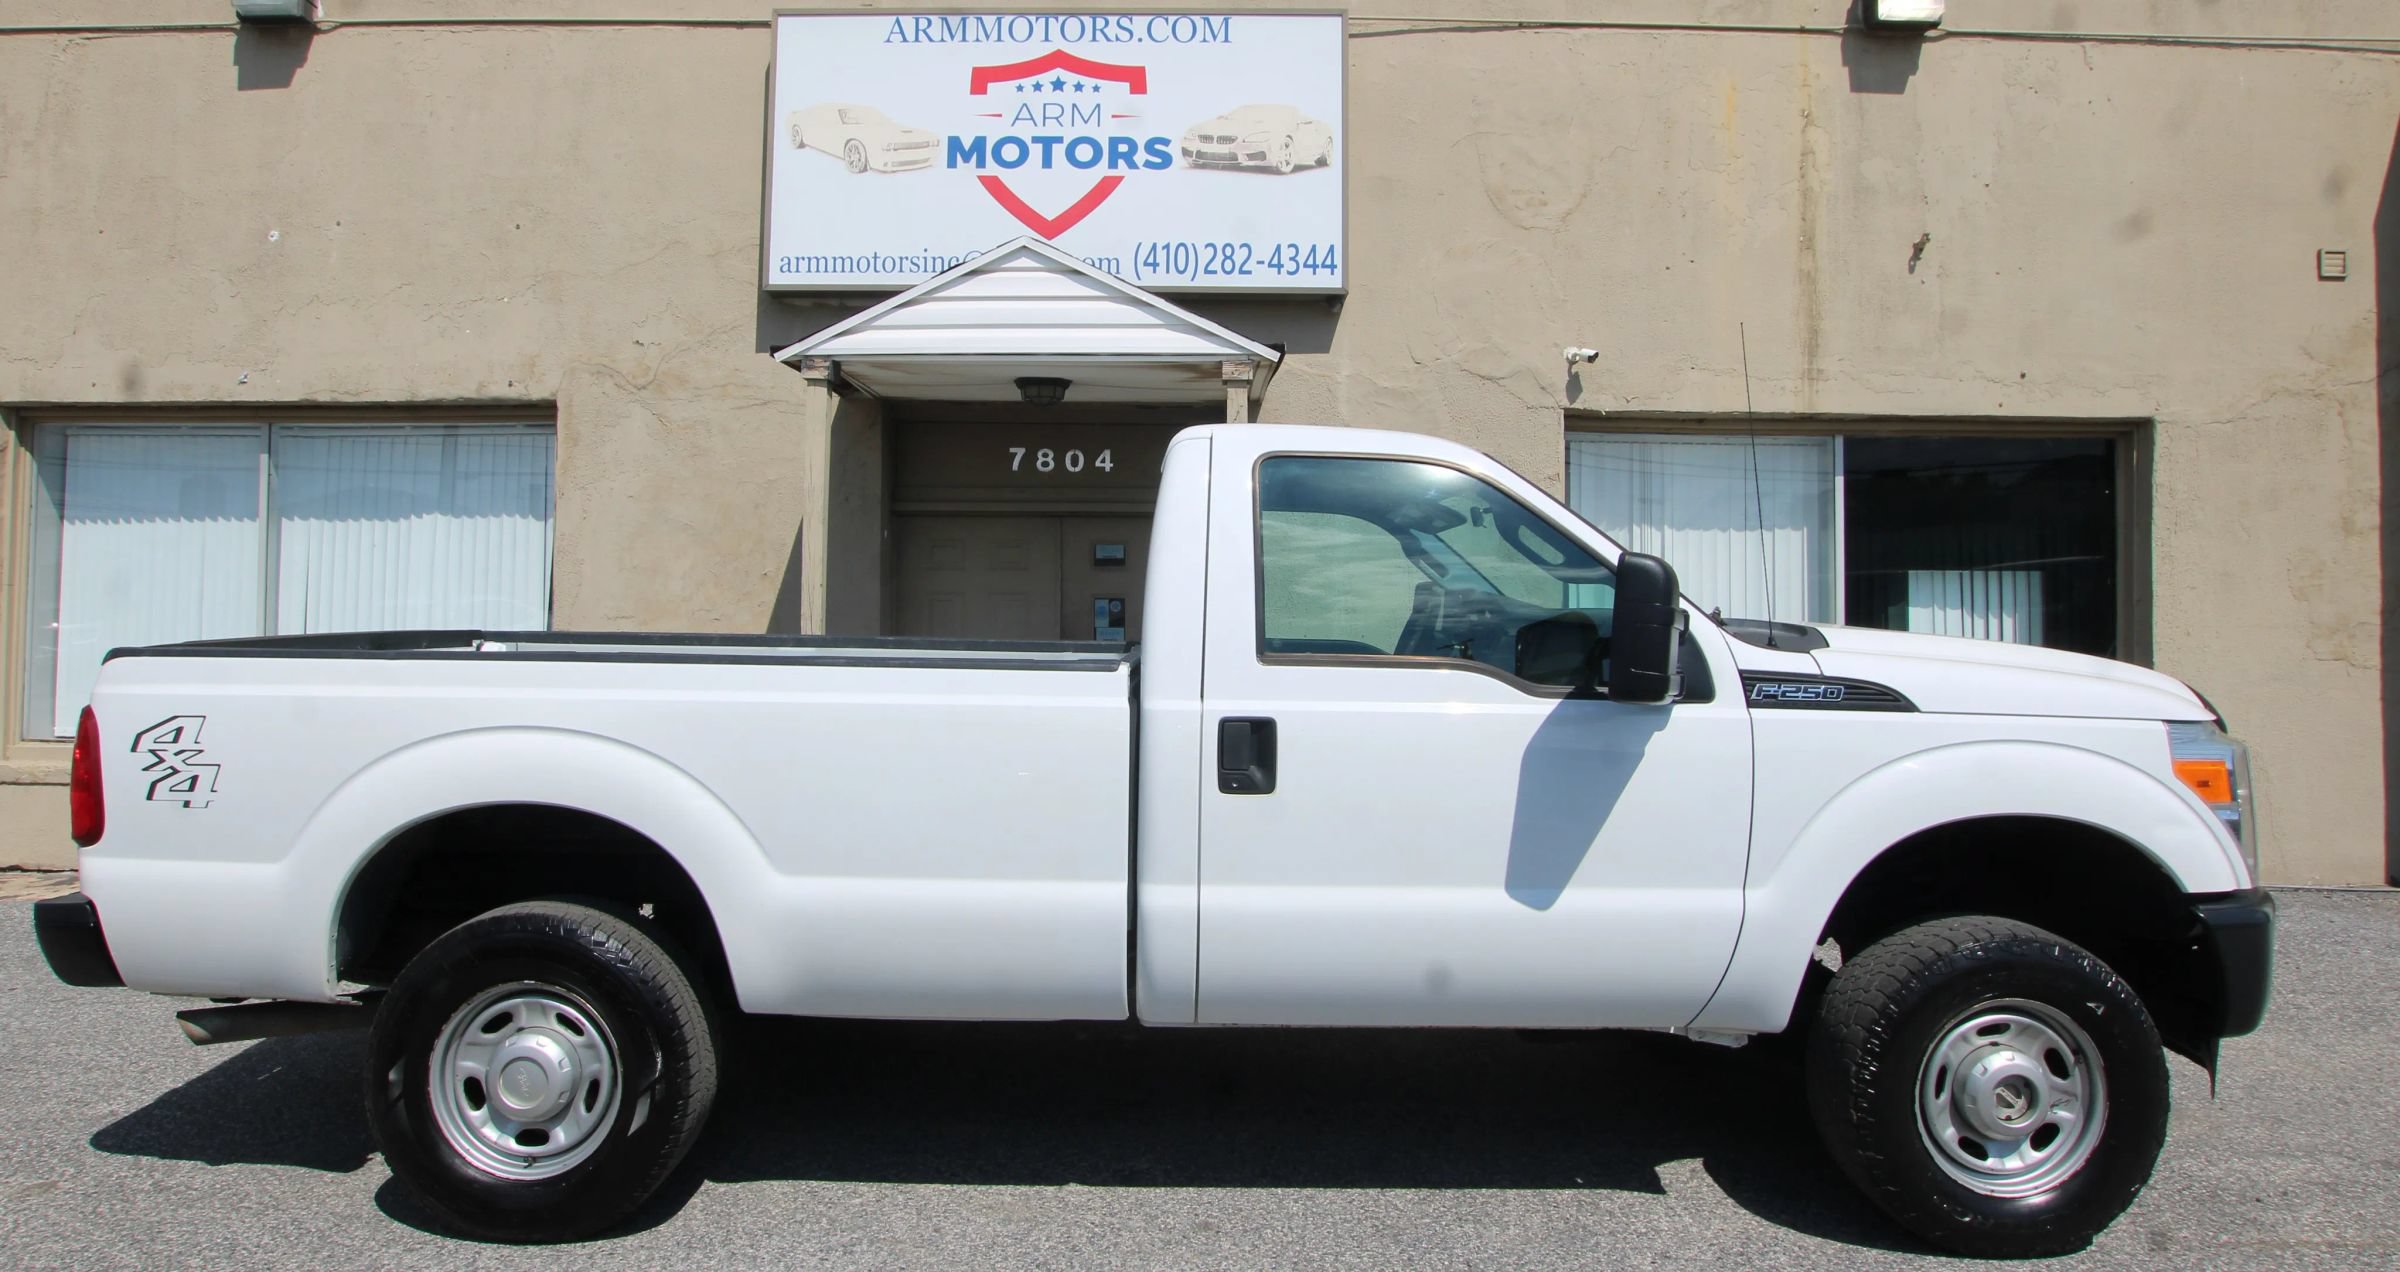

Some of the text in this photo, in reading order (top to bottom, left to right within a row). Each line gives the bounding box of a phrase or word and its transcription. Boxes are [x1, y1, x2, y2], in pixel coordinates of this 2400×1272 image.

[884, 15, 1232, 44] ARMMOTORS.COM
[1010, 102, 1101, 128] ARM
[946, 135, 1174, 171] MOTORS
[1009, 447, 1114, 472] 7804
